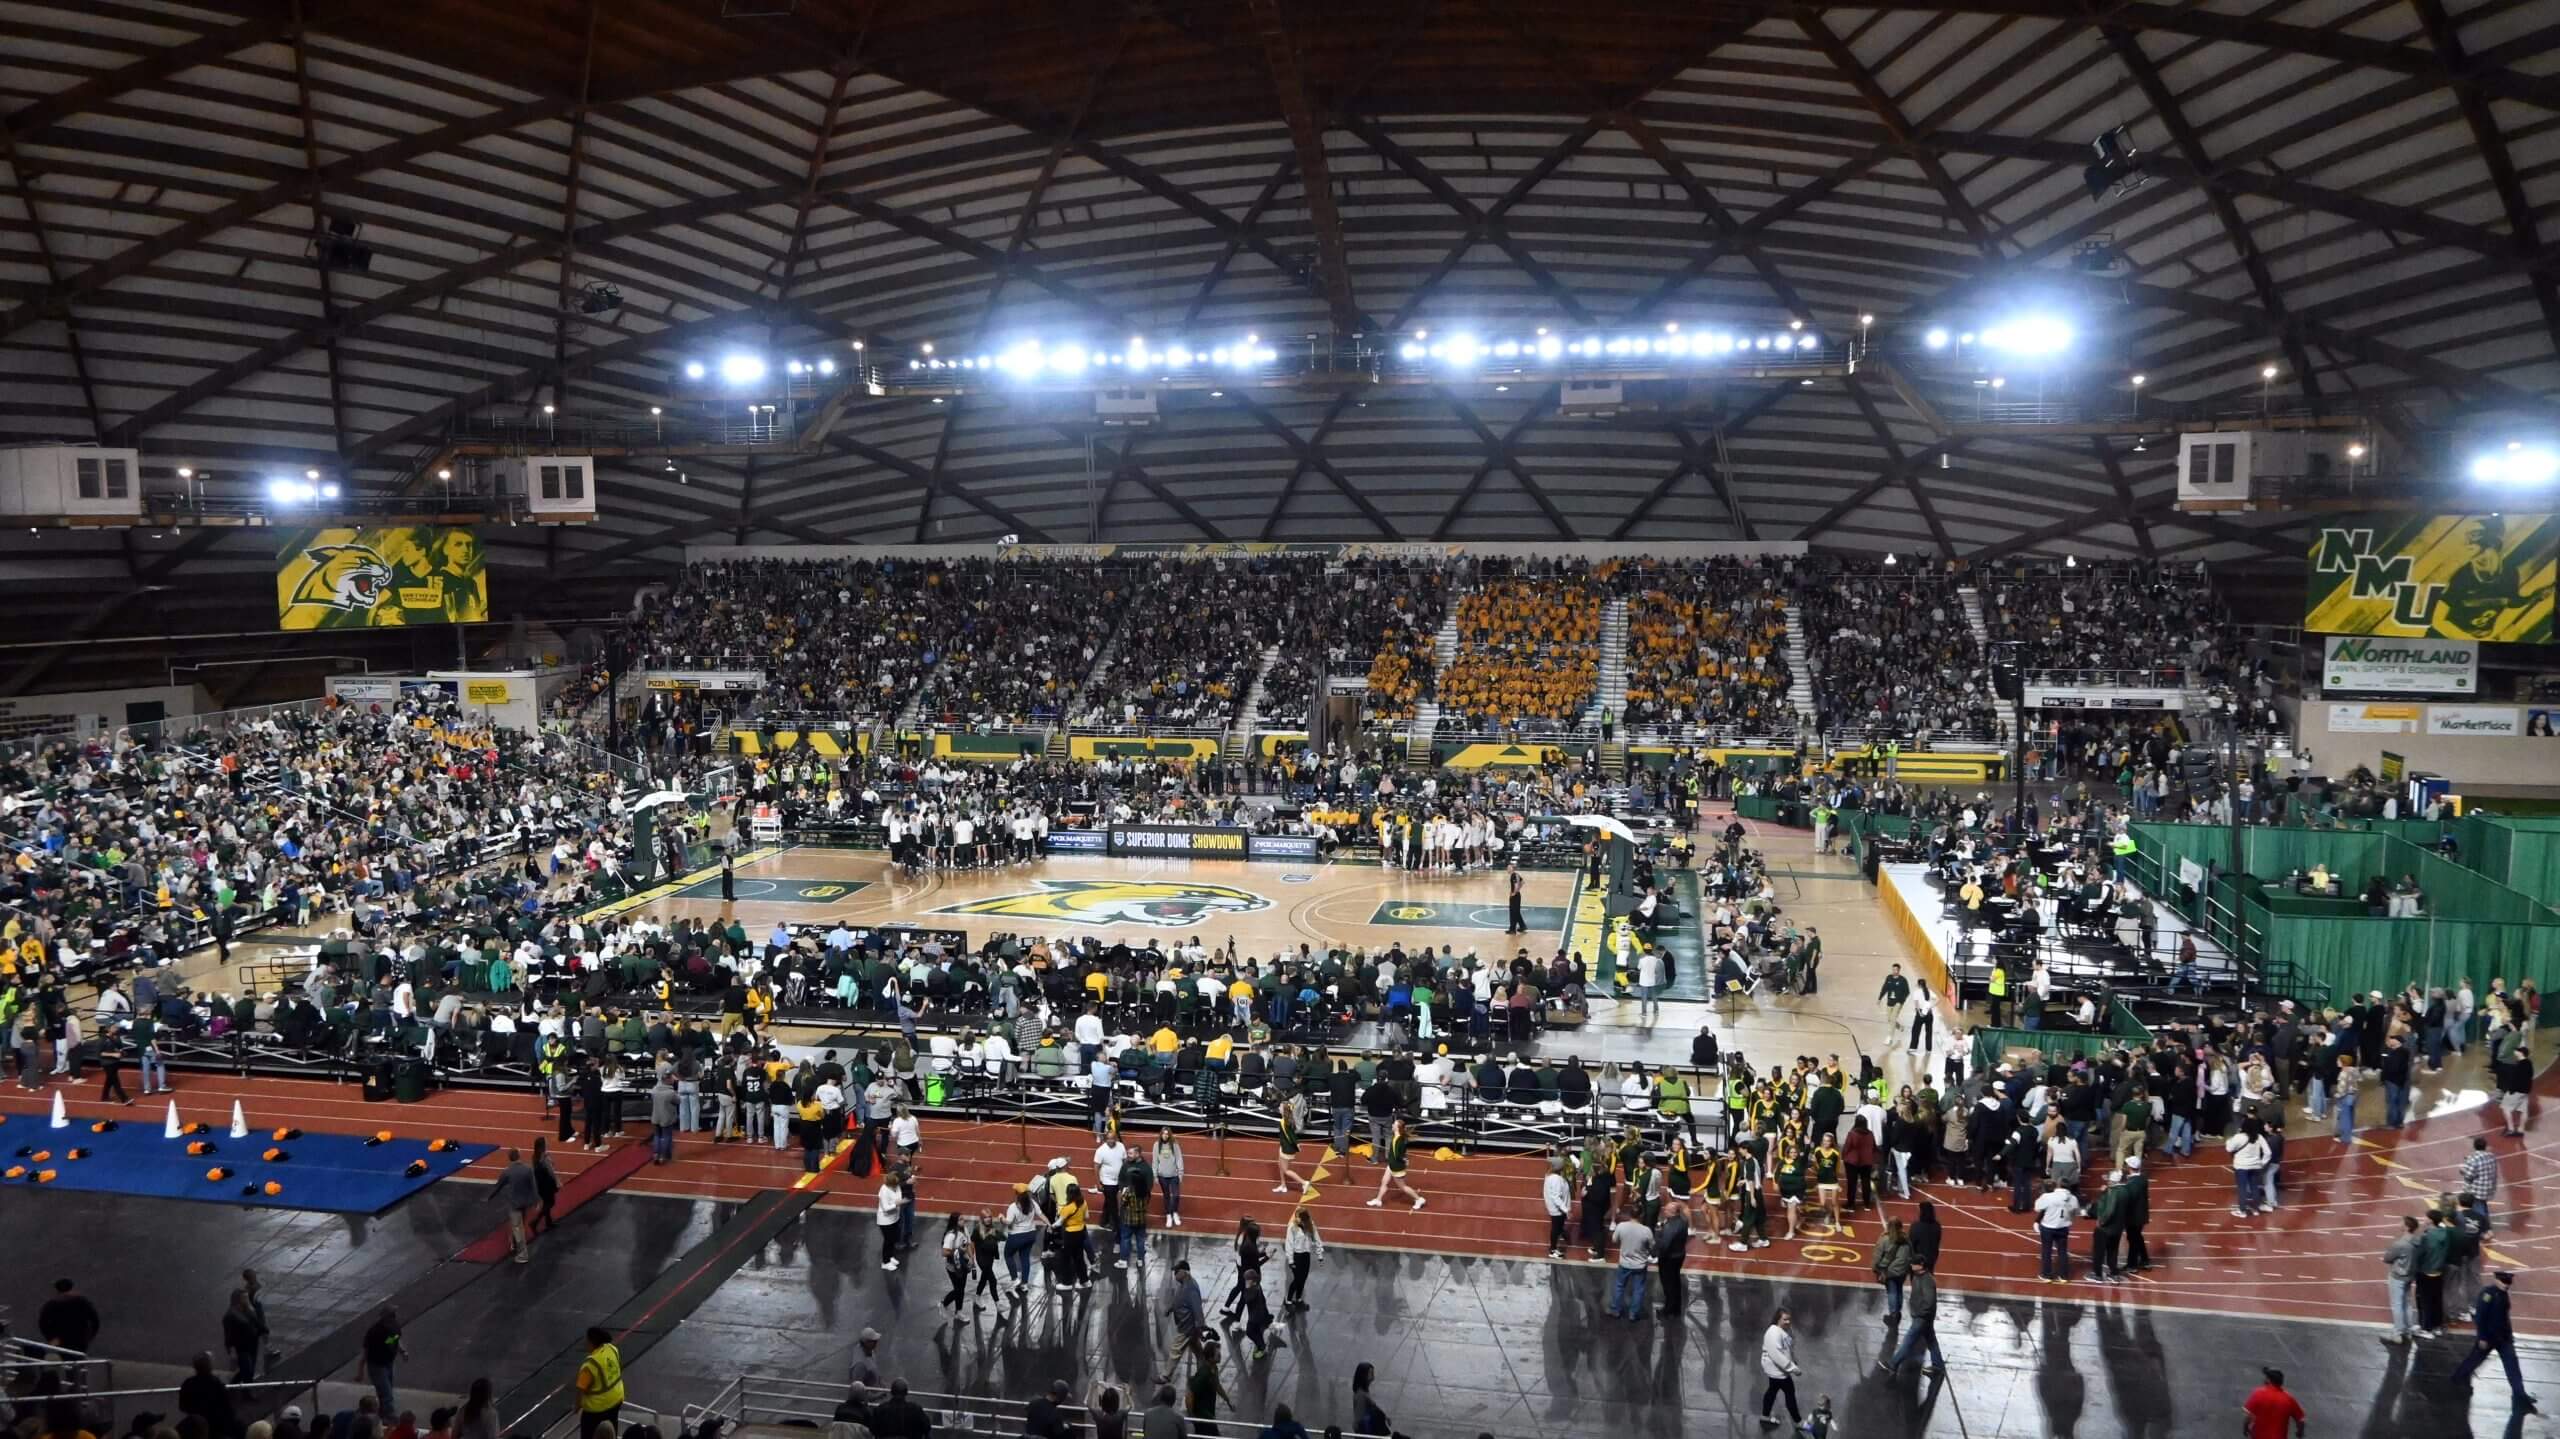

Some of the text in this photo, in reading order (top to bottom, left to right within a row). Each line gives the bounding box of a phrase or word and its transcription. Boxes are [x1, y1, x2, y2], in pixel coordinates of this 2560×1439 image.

[426, 576, 444, 589] 15
[2316, 528, 2446, 628] NMU
[2329, 639, 2471, 664] NORTHLAND
[1126, 832, 1243, 850] SUPERIOR DOME SHOWDOWN
[746, 1081, 761, 1092] 22
